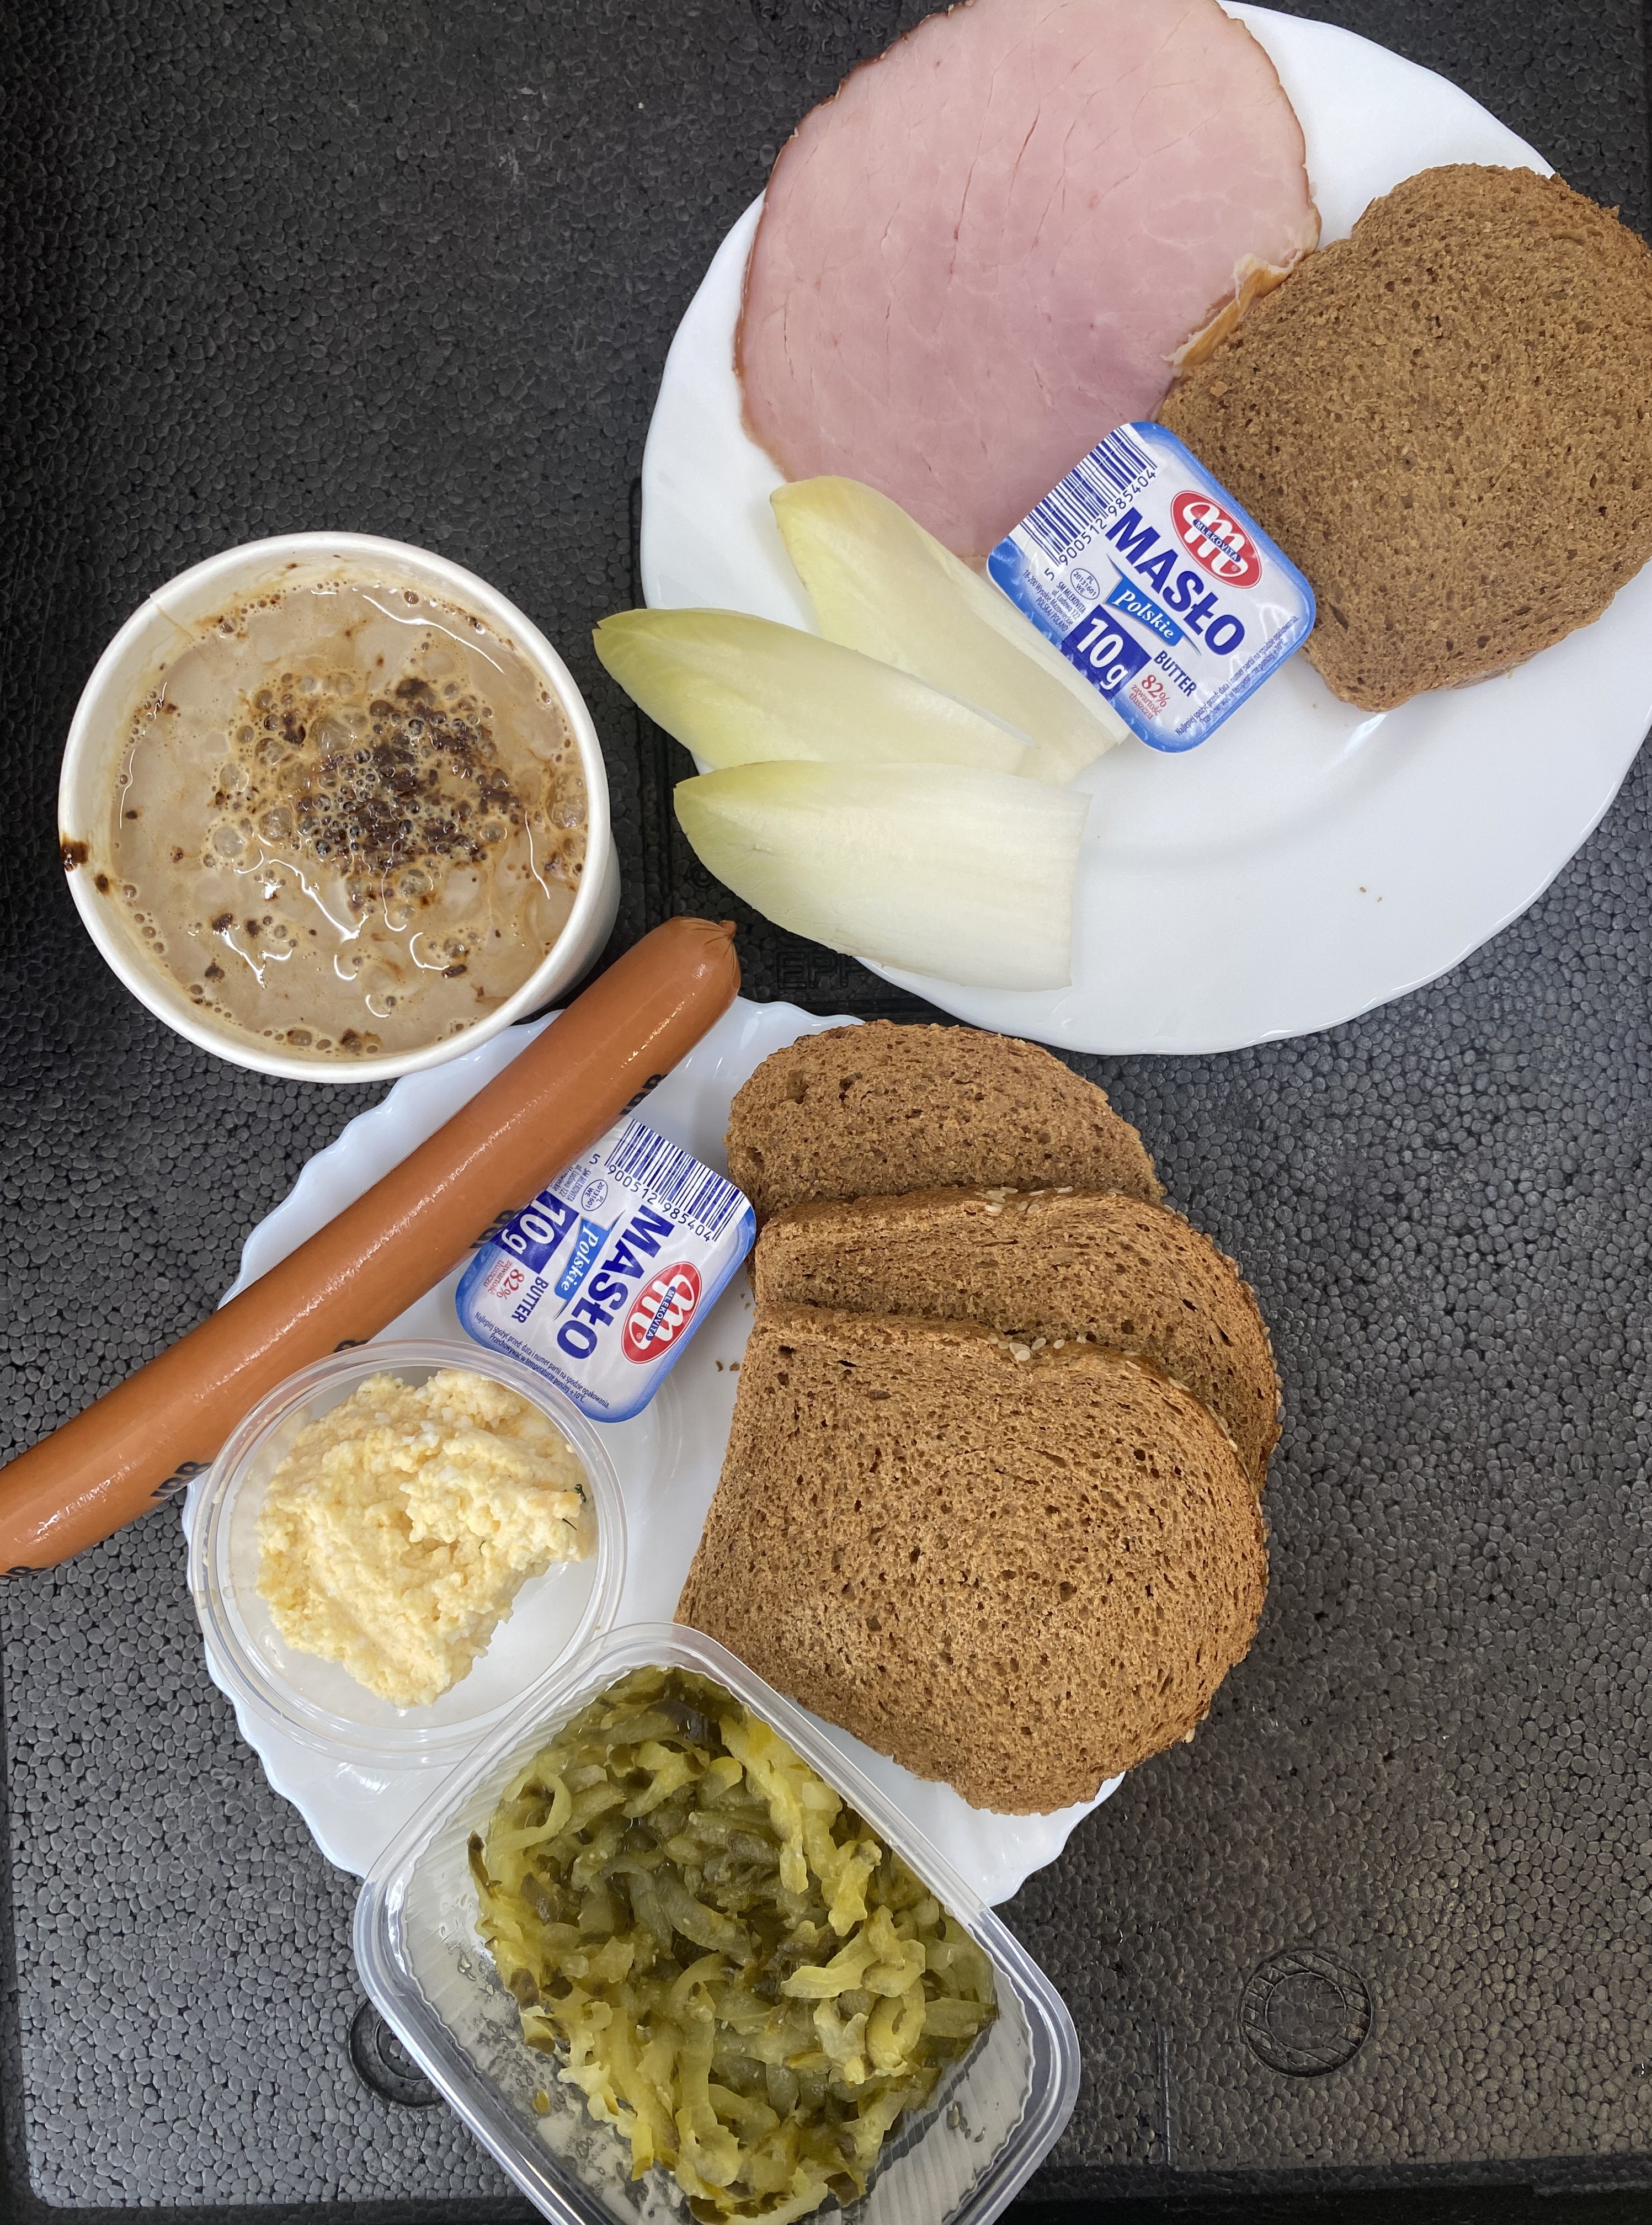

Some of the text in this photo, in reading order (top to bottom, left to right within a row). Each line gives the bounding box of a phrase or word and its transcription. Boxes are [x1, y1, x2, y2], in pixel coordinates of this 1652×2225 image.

[1044, 467, 1158, 582] 5 900512 985404
[1195, 521, 1238, 561] MLEKOVITA
[1021, 569, 1039, 587] 18-200
[1032, 583, 1053, 604] Wysokie
[1072, 571, 1097, 597] 20131601
[1075, 583, 1085, 594] WE
[1085, 576, 1095, 584] PL
[1104, 507, 1245, 656] MASŁO
[1056, 581, 1087, 614] SM MLEKOVITA
[1056, 594, 1074, 613] Ludowa
[1069, 609, 1080, 620] 122
[1111, 588, 1174, 639] Polskie
[1049, 613, 1069, 632] POLAND
[1153, 650, 1199, 698] BUTTER
[1127, 692, 1155, 720] tłuszczu
[1129, 683, 1163, 717] zawartość
[1141, 674, 1168, 709] 82%
[558, 1187, 568, 1197] 122
[564, 1170, 579, 1189] Ludowa
[566, 1168, 591, 1202] SM MLEKOVITA
[584, 1186, 593, 1197] WE
[585, 1181, 604, 1209] 20131601
[588, 1152, 713, 1243] 5 900512 985404
[595, 1195, 603, 1204] PL
[482, 1259, 504, 1288] tłuszczu
[560, 1225, 600, 1292] Polskie
[487, 1259, 513, 1295] zawartość
[495, 1269, 525, 1301] 82%
[557, 1204, 675, 1360] MASŁO
[510, 1276, 549, 1324] BUTTER
[646, 1289, 674, 1338] MLEKOVITA
[472, 1311, 496, 1331] Najlepiej
[492, 1324, 510, 1341] spożyć
[507, 1334, 524, 1349] przed:
[520, 1343, 534, 1355] data
[532, 1353, 550, 1367] numer
[547, 1362, 562, 1375] partii
[564, 1374, 584, 1391] spodzie
[580, 1386, 612, 1409] opakowania.
[487, 1332, 524, 1360] Przechowywać
[524, 1358, 556, 1381] temperaturze
[552, 1377, 572, 1393] poniżej
